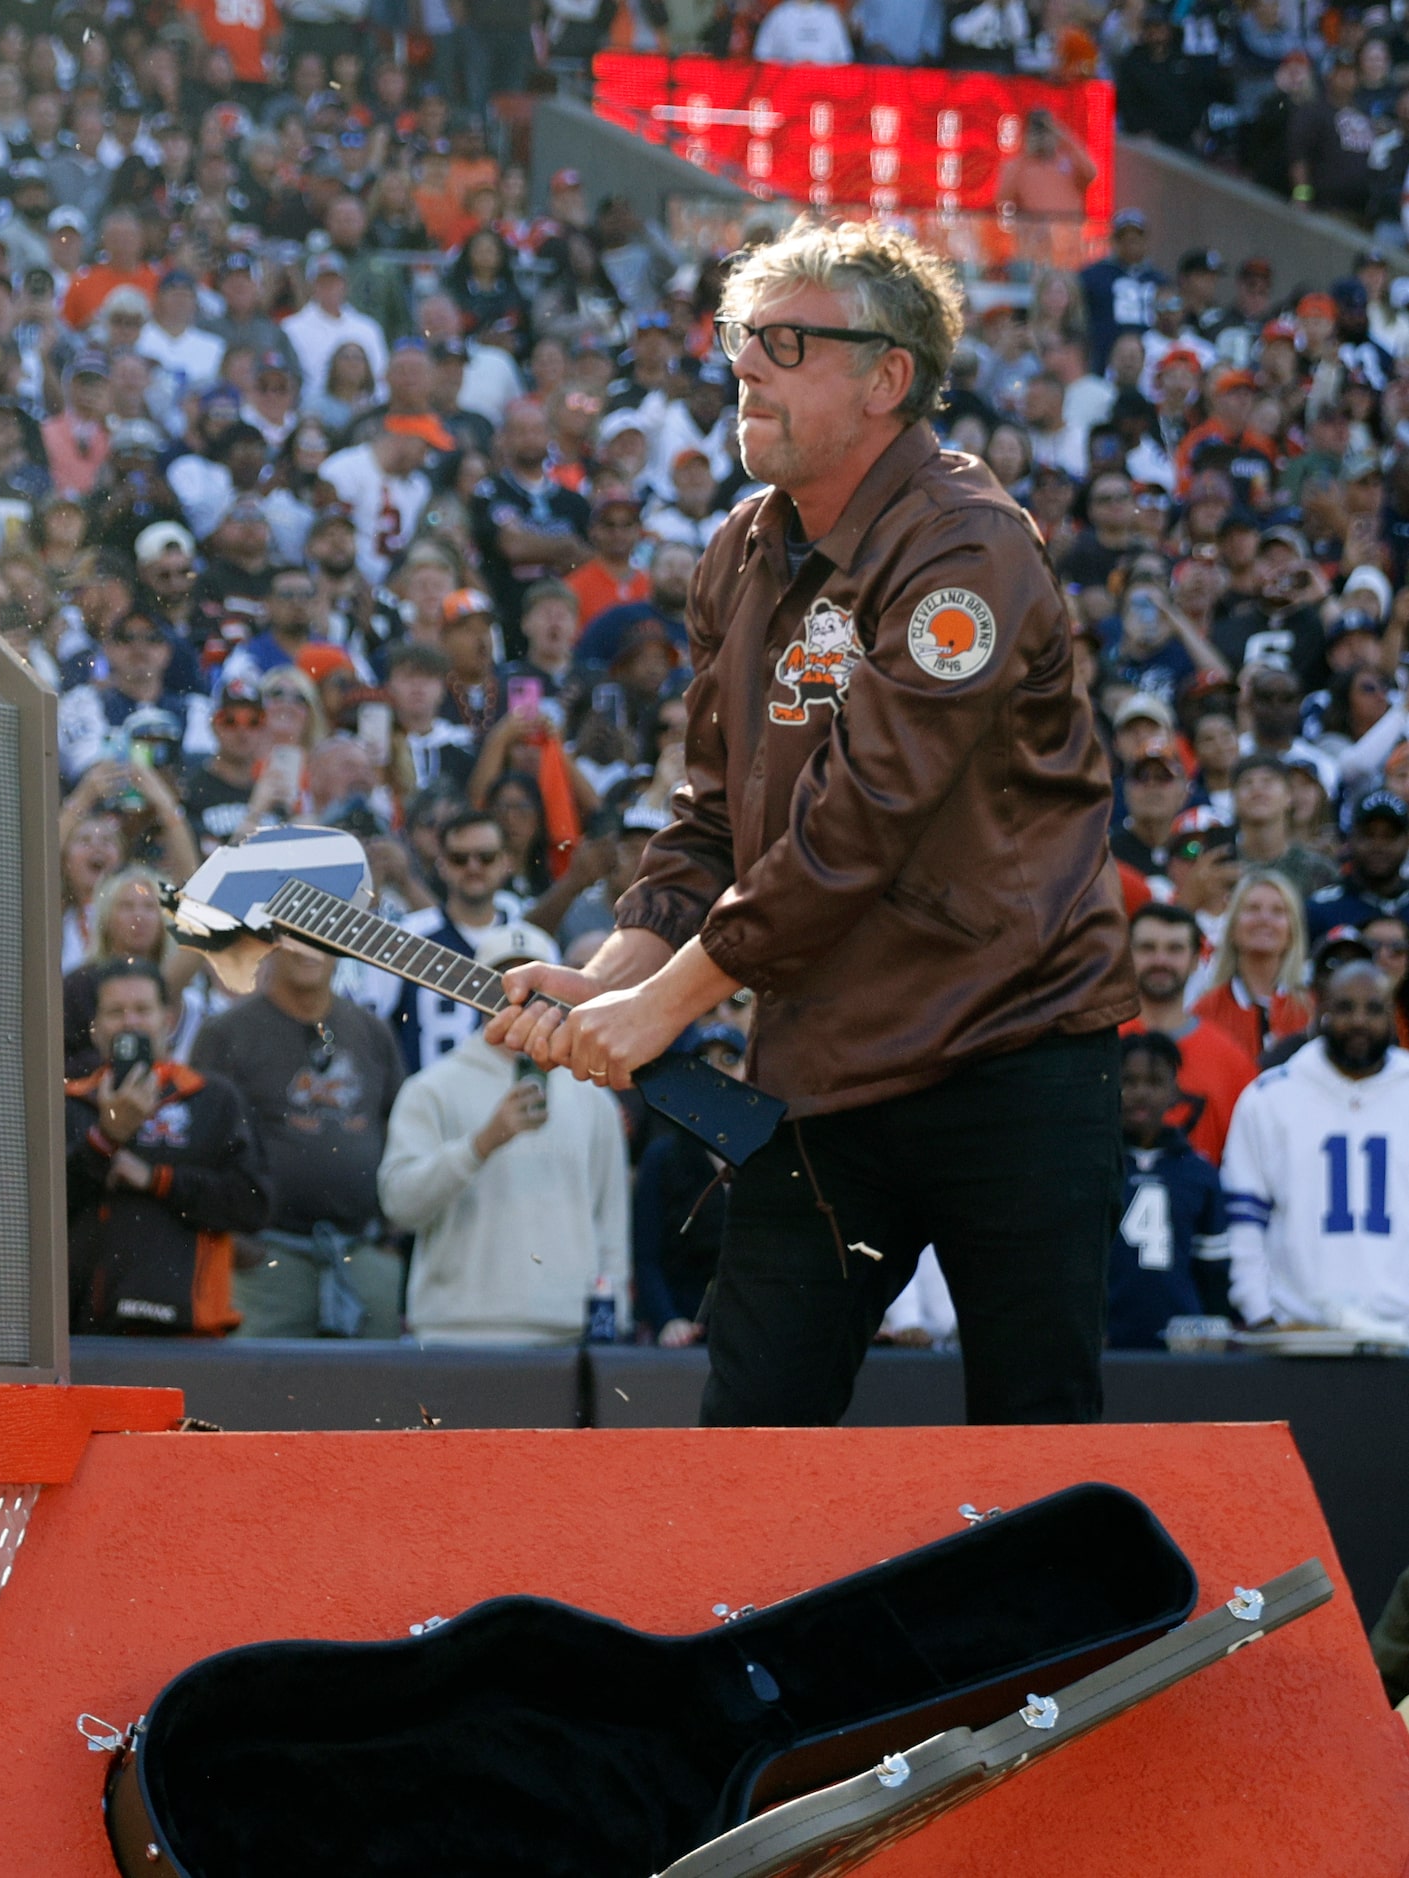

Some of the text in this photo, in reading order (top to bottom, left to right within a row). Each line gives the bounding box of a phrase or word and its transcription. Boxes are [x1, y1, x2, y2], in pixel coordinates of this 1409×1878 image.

[912, 591, 992, 650] CLEVELAND BROWNS
[933, 658, 961, 672] 1946
[1320, 1132, 1392, 1237] 11
[1119, 1182, 1174, 1270] 4
